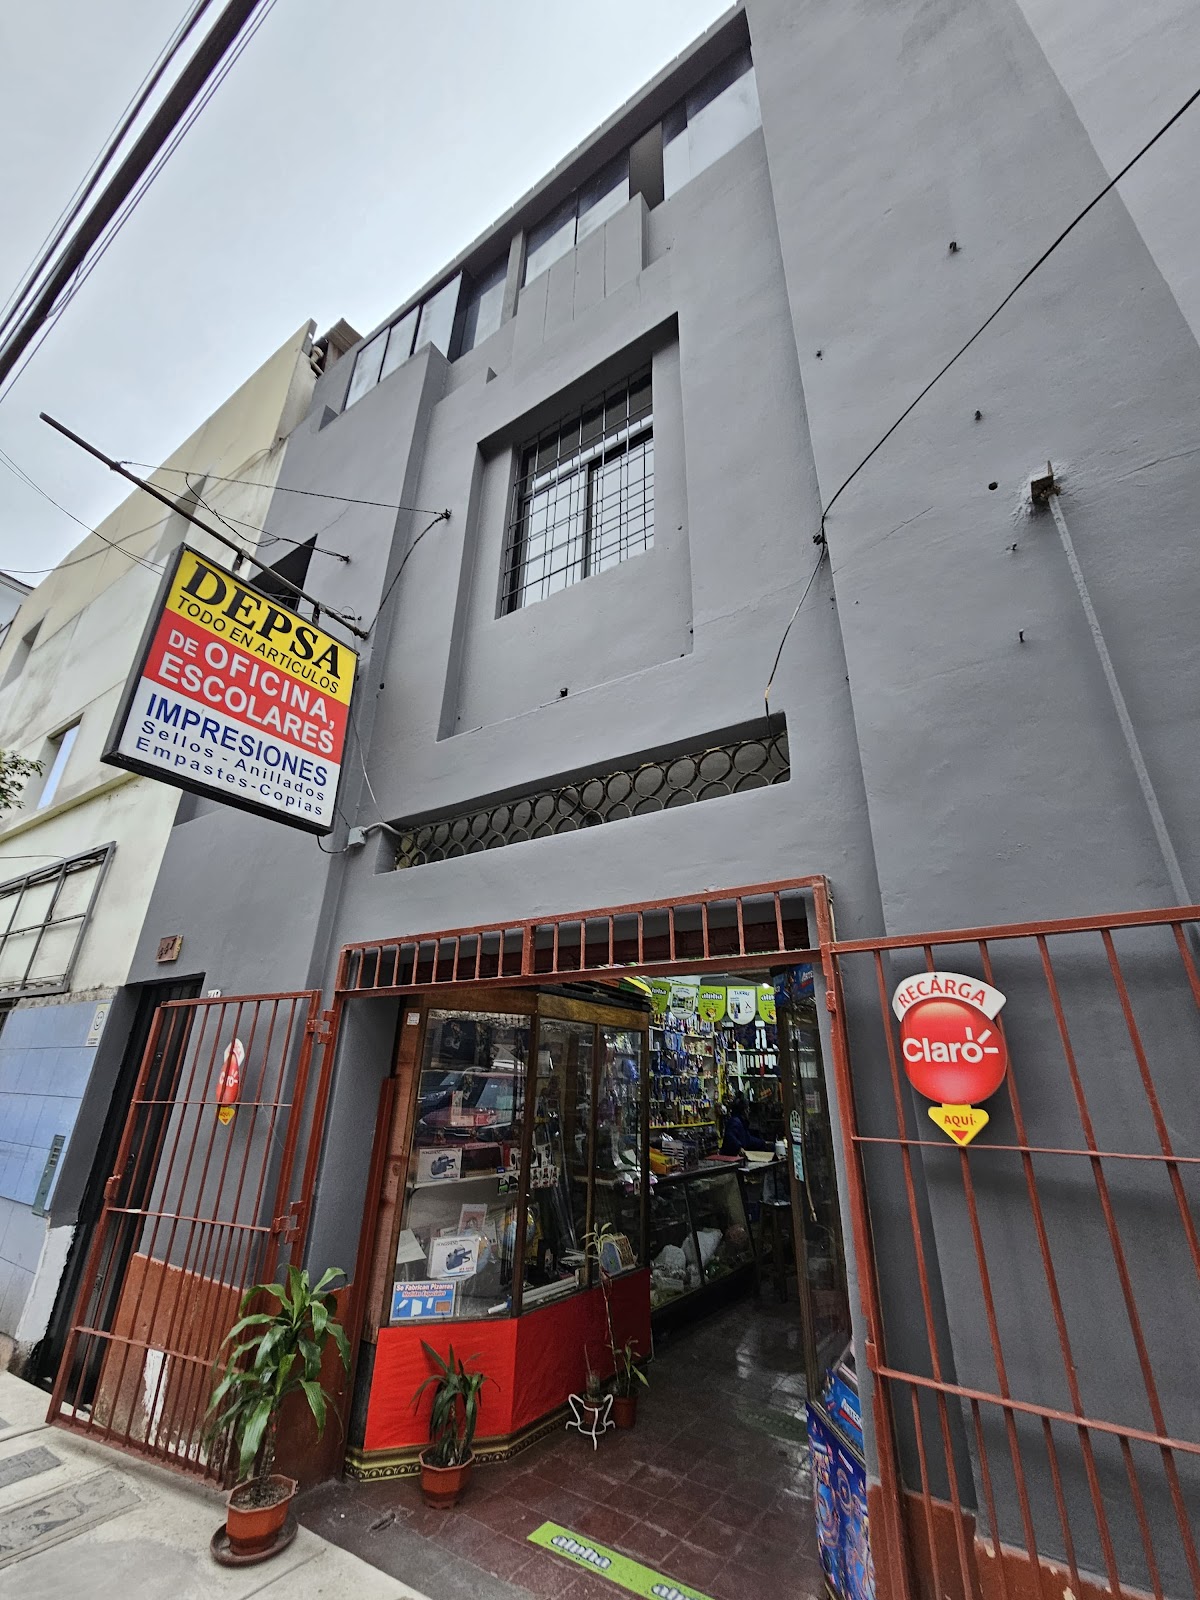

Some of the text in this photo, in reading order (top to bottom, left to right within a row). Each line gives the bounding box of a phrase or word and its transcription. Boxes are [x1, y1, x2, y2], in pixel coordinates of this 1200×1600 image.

[176, 595, 339, 694] TODO EN ARTICULOS
[181, 560, 340, 679] DEPSA
[158, 652, 333, 754] ESCOLARES
[168, 629, 335, 729] DE OFICINA,
[141, 720, 214, 758] Sellos
[234, 759, 325, 801] Anillados
[146, 693, 328, 787] IMPRESIONES
[898, 979, 987, 1009] RECARGA
[903, 1029, 992, 1064] Claro
[551, 1535, 612, 1569] alpha
